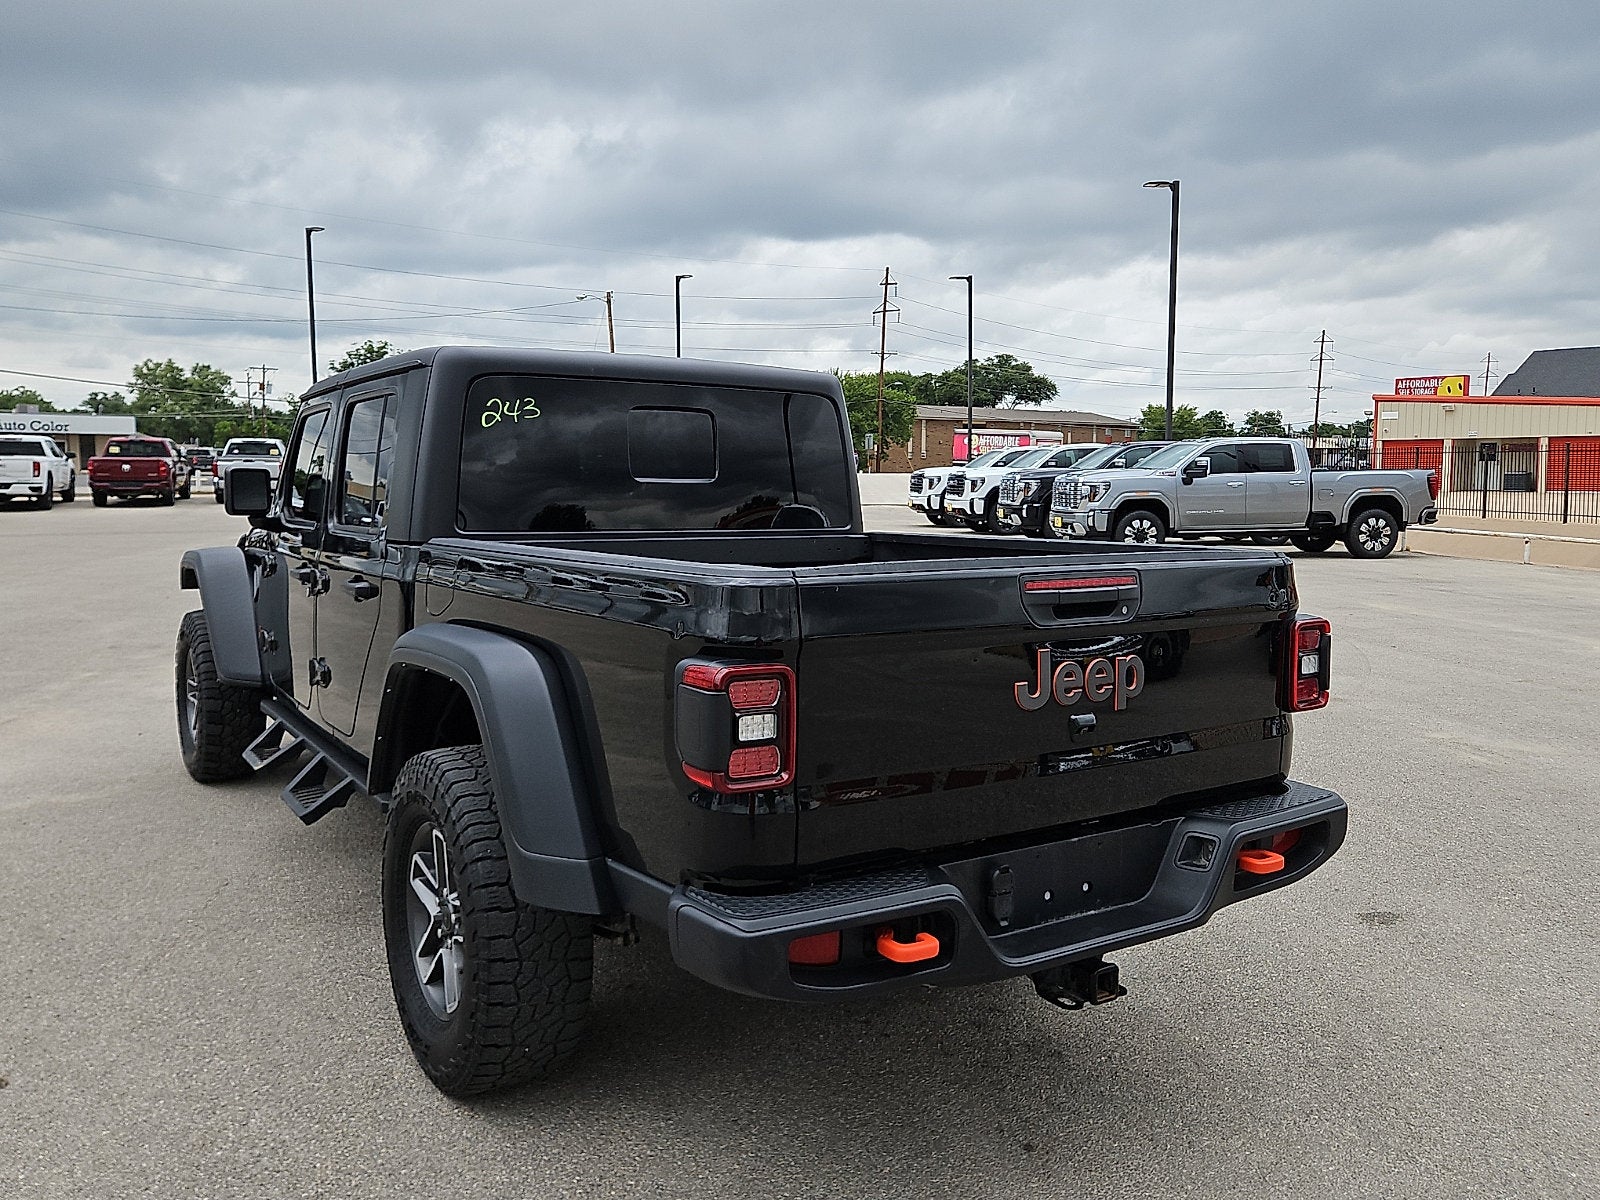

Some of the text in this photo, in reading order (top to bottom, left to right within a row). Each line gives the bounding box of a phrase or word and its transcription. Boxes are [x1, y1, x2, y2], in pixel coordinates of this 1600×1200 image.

[1397, 379, 1443, 388] AFFORDABLE
[1398, 387, 1435, 396] SELF STORAGE
[481, 397, 541, 428] 243
[30, 420, 70, 432] Color
[979, 435, 1020, 447] AFFORDABLE
[1014, 648, 1145, 712] Jeep
